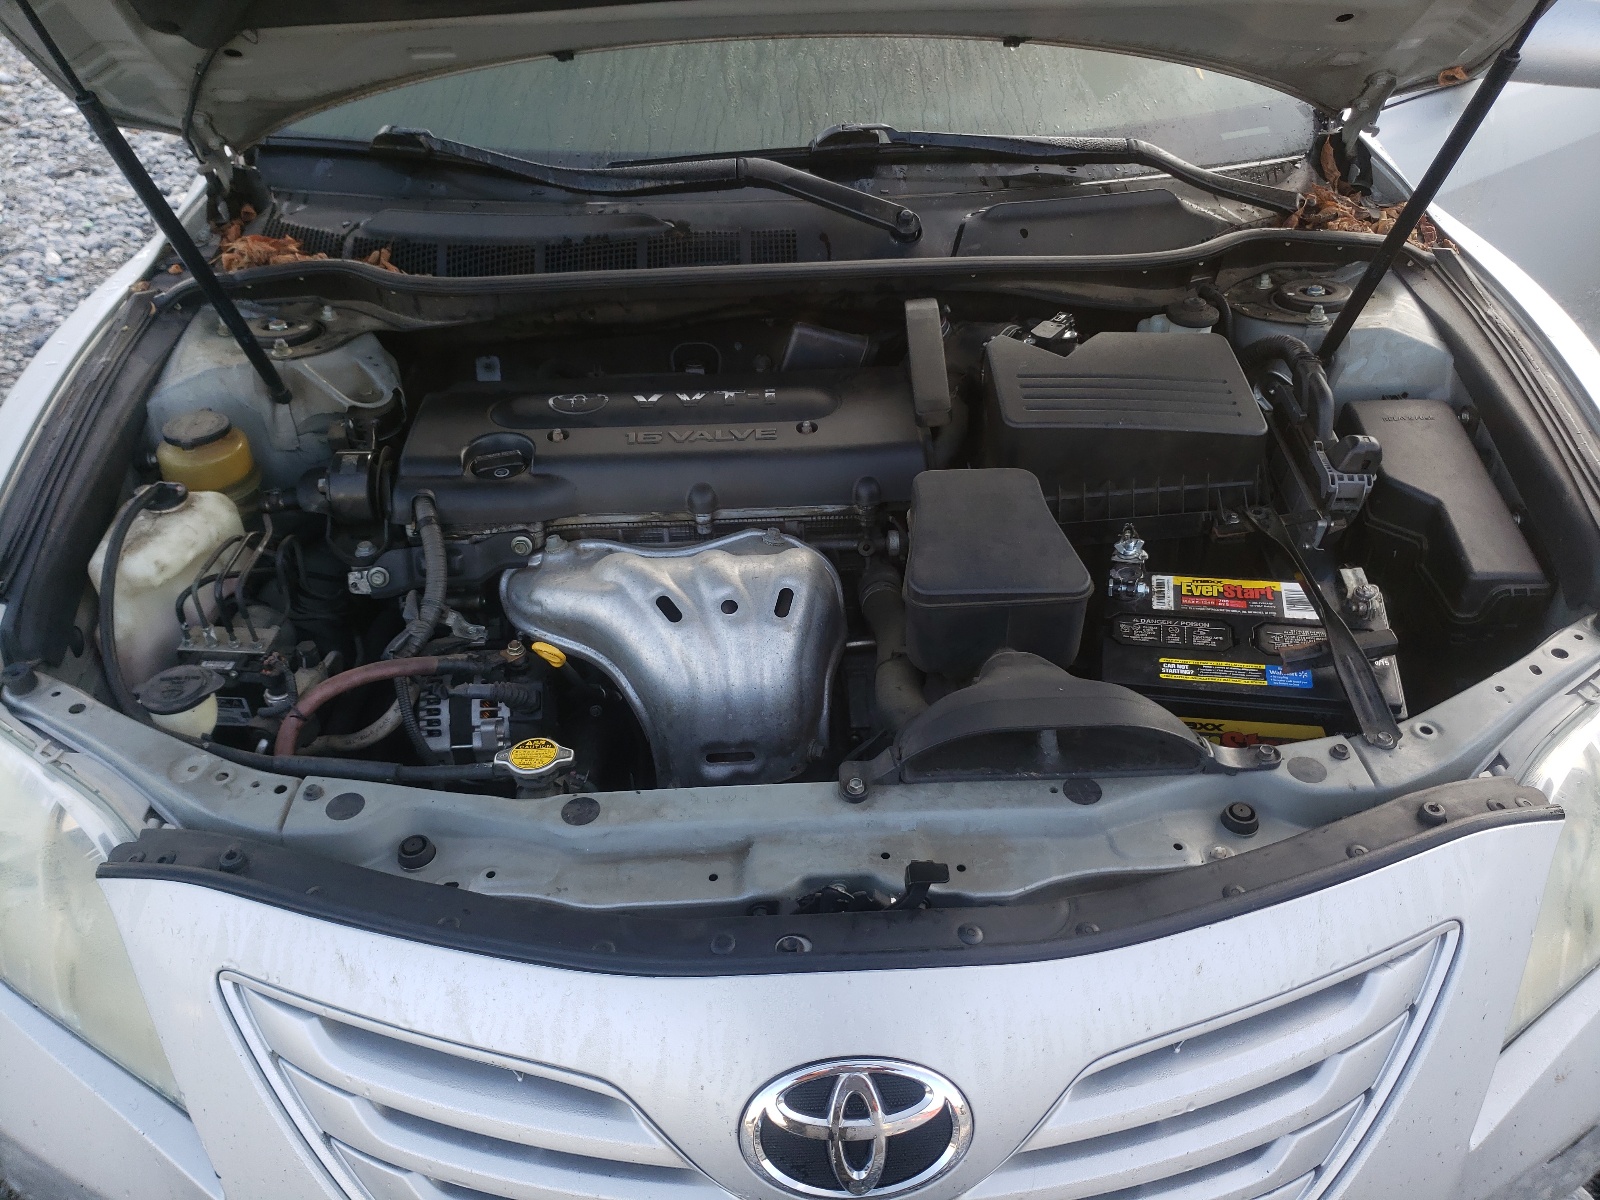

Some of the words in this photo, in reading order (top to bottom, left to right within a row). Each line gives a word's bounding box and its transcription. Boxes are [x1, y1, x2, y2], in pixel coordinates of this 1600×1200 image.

[625, 431, 663, 445] 16
[668, 427, 778, 443] VALVE
[1181, 581, 1275, 600] EverStart
